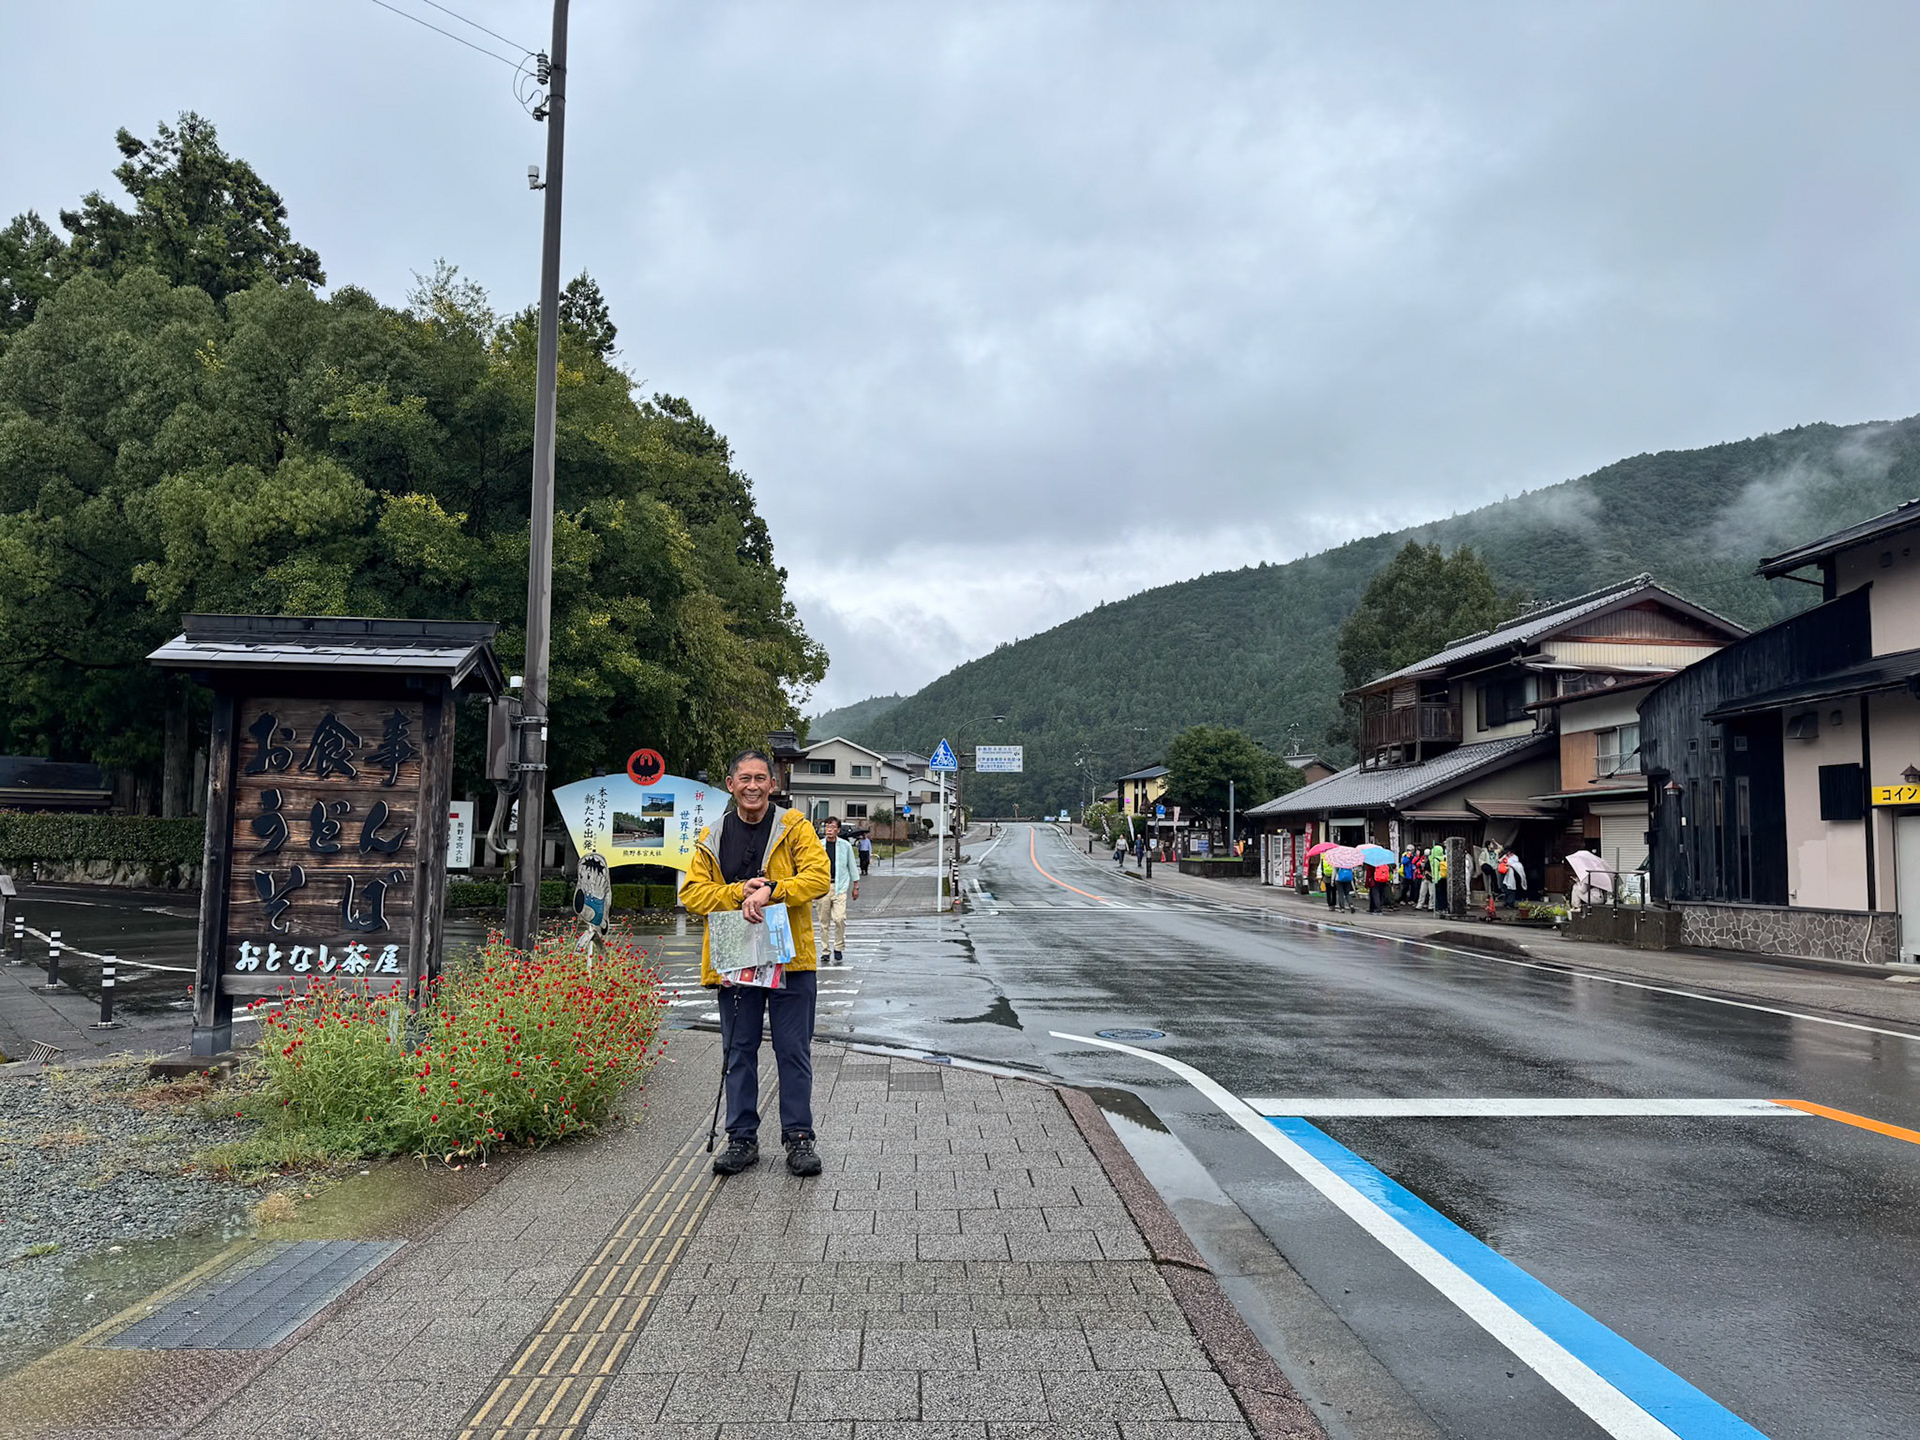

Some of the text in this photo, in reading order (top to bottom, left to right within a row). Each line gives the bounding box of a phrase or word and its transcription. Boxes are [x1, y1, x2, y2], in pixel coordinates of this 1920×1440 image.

[245, 708, 418, 786] お食事
[597, 787, 608, 831] 本宮より
[1061, 809, 1068, 817] P
[1882, 787, 1918, 801] コイン
[252, 787, 410, 856] うどん
[456, 823, 464, 862] 熊野本宮大社
[584, 793, 595, 850] 新たな出発
[679, 810, 690, 855] 世界平和
[622, 849, 662, 857] 熊野本宮大社
[254, 865, 407, 935] そば
[234, 940, 401, 974] おとなし茶屋
